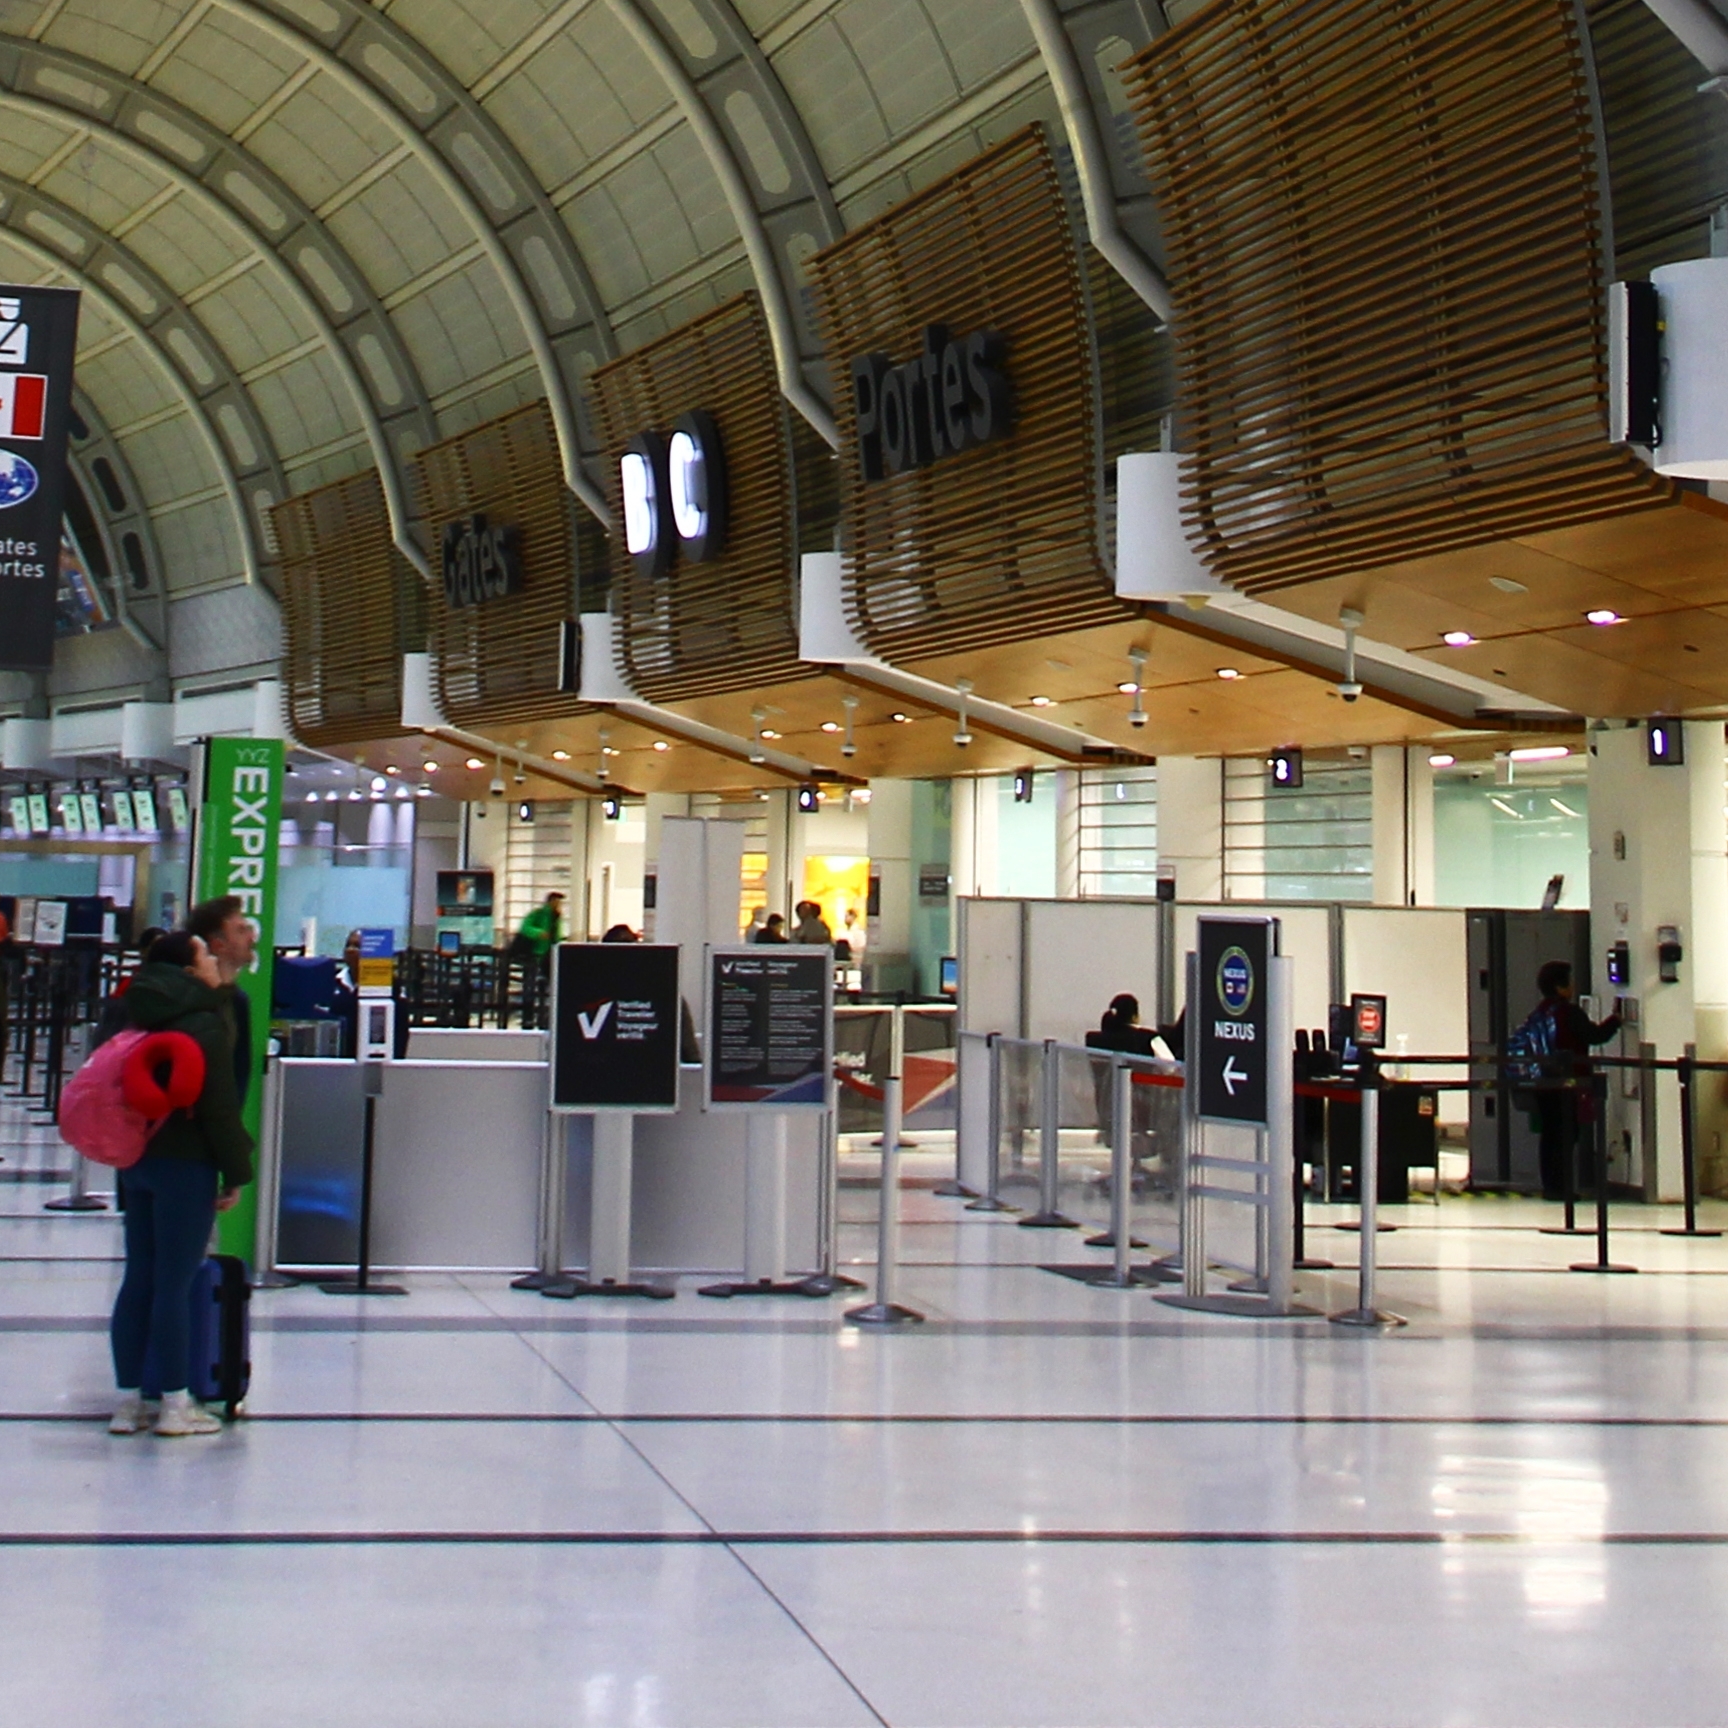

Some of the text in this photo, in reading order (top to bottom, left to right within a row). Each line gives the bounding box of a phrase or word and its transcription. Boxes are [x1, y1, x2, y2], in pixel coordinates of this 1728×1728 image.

[852, 325, 1010, 481] Portes
[443, 515, 516, 609] Gates
[236, 747, 270, 764] YYZ
[227, 767, 270, 974] EXPRE
[1223, 967, 1247, 979] NEXUS
[1214, 1020, 1256, 1041] NEXUS
